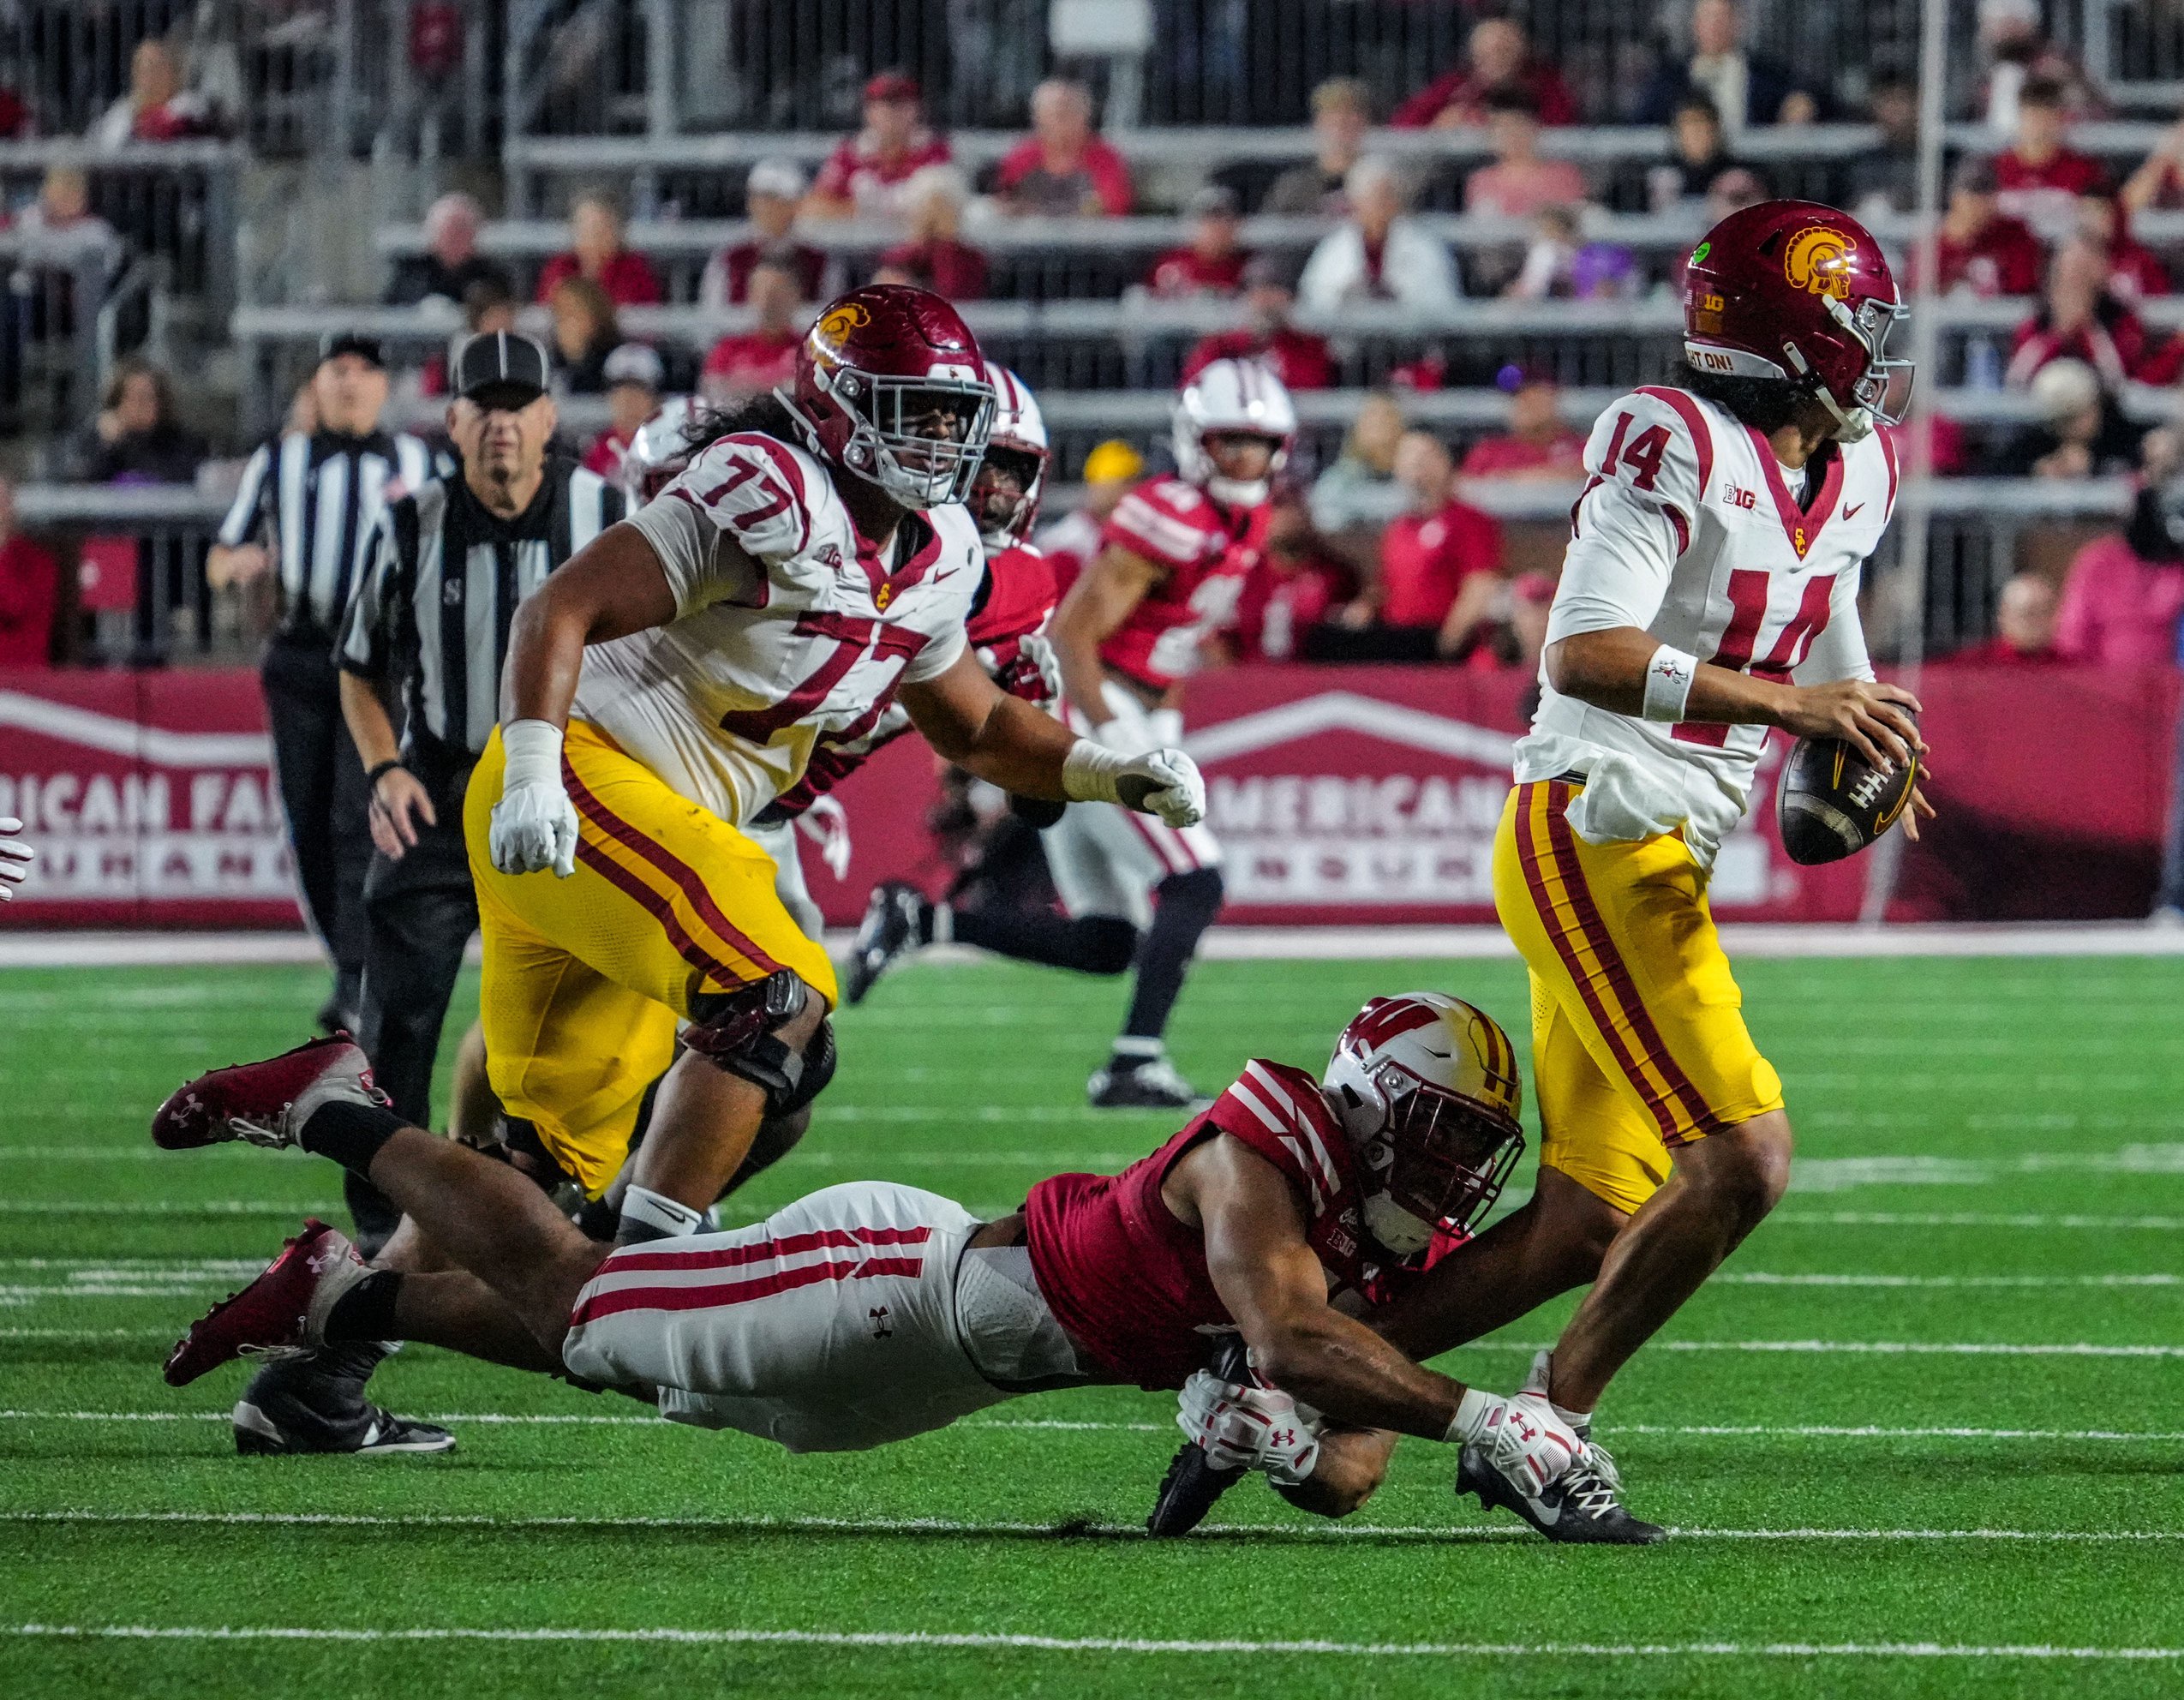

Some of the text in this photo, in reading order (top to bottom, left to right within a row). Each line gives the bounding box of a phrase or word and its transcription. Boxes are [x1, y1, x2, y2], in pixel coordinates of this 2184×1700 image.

[1705, 352, 1734, 371] ON!
[703, 453, 793, 531] 77
[1601, 411, 1672, 493] 14
[718, 610, 932, 745] 77
[1670, 568, 1838, 749] 14
